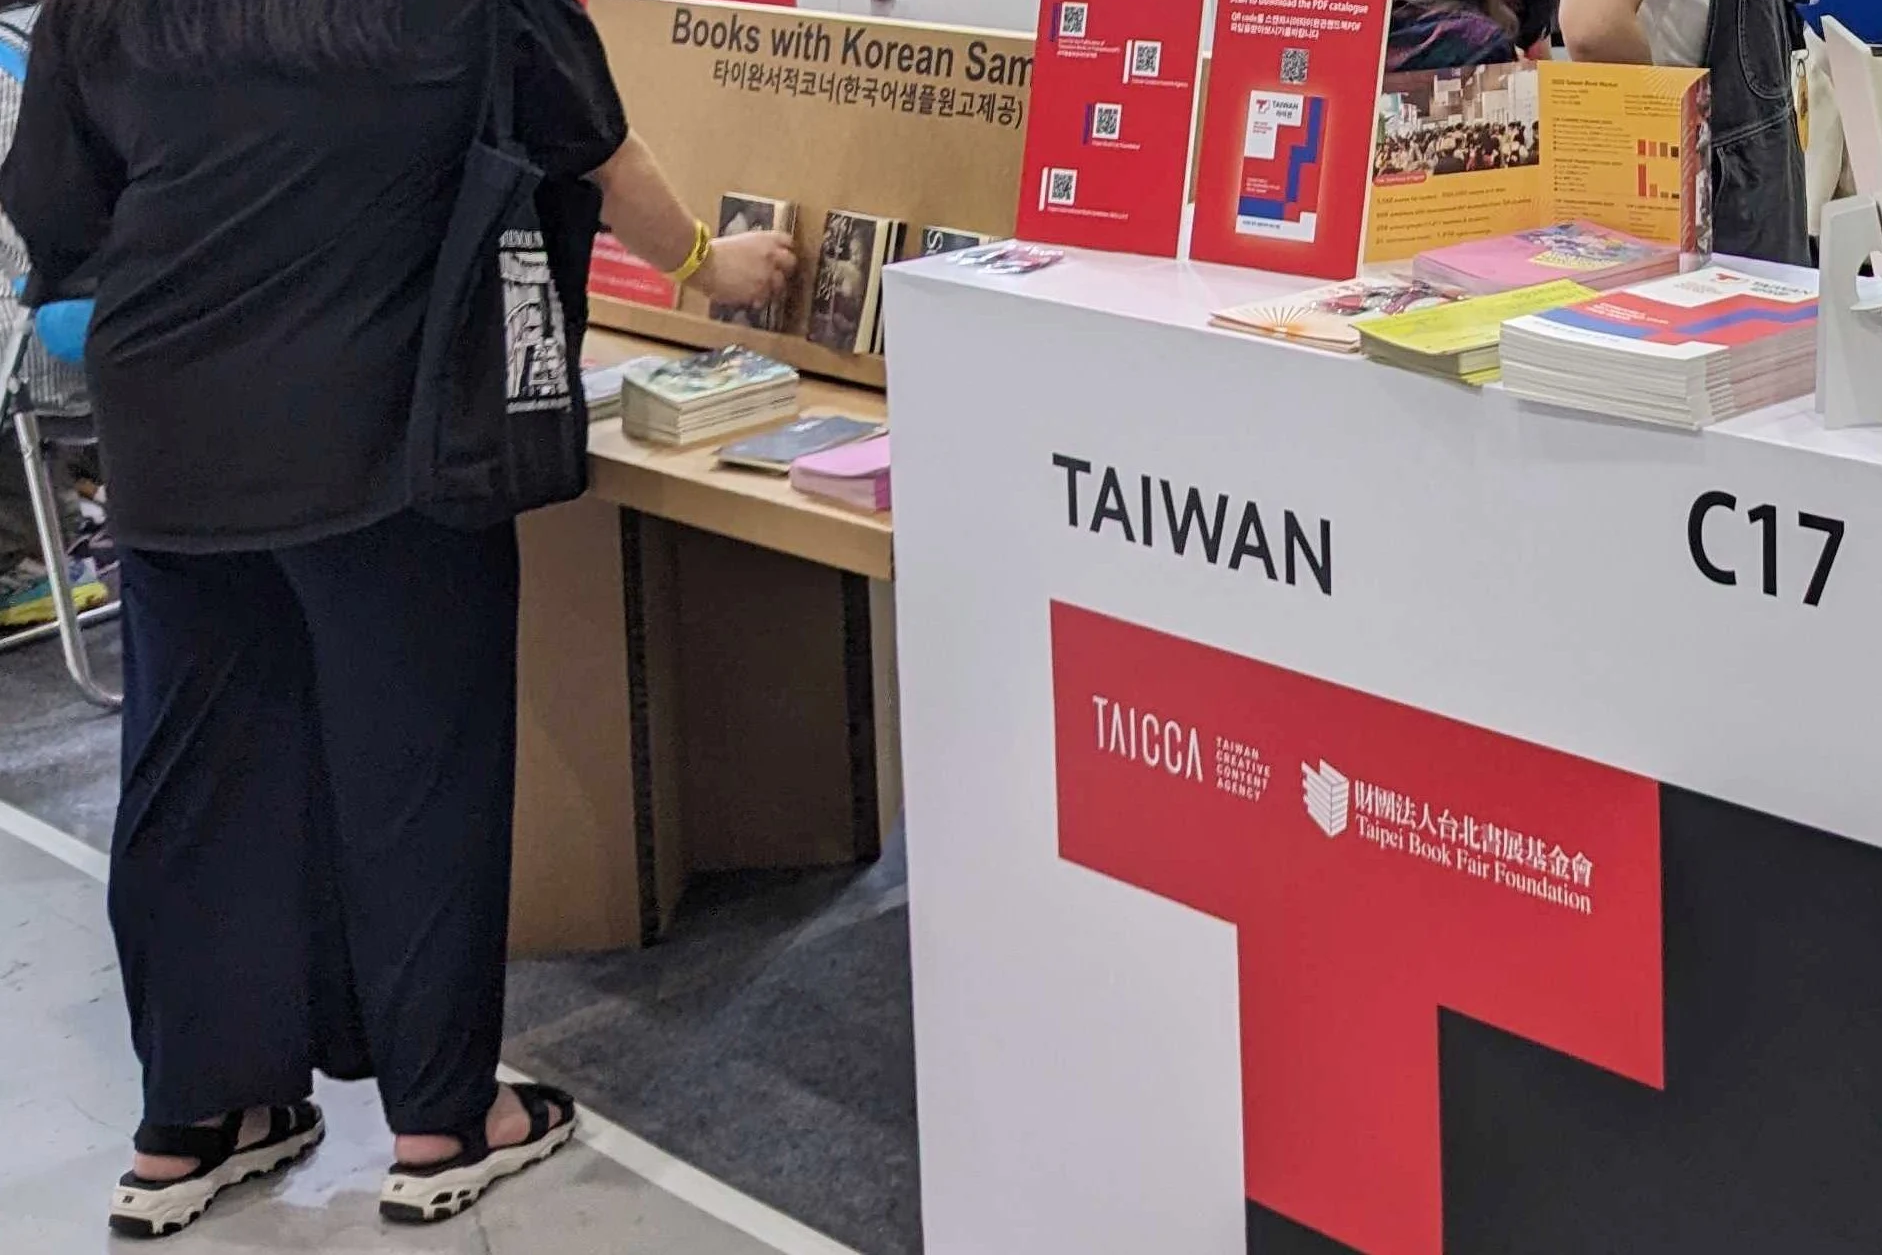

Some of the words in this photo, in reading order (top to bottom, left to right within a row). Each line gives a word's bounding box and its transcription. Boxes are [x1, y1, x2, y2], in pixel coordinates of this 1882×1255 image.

[671, 7, 760, 55] Books
[771, 23, 831, 63] with
[841, 26, 955, 79] Korean
[1329, 0, 1369, 15] catalogue
[1053, 453, 1333, 597] TAIWAN
[1687, 489, 1846, 608] C17
[1092, 695, 1203, 783] TAICCA
[1216, 735, 1259, 759] TAIWAN
[1216, 749, 1271, 778] CREATIVE
[1216, 763, 1268, 791] CONTENT
[1217, 778, 1261, 802] AGENCY
[1354, 778, 1593, 888] 財團法人台北書展基金會
[1355, 812, 1403, 850] Taipei
[1409, 831, 1451, 868] Book
[1456, 847, 1491, 879] Fair
[1494, 860, 1593, 915] Foundation
